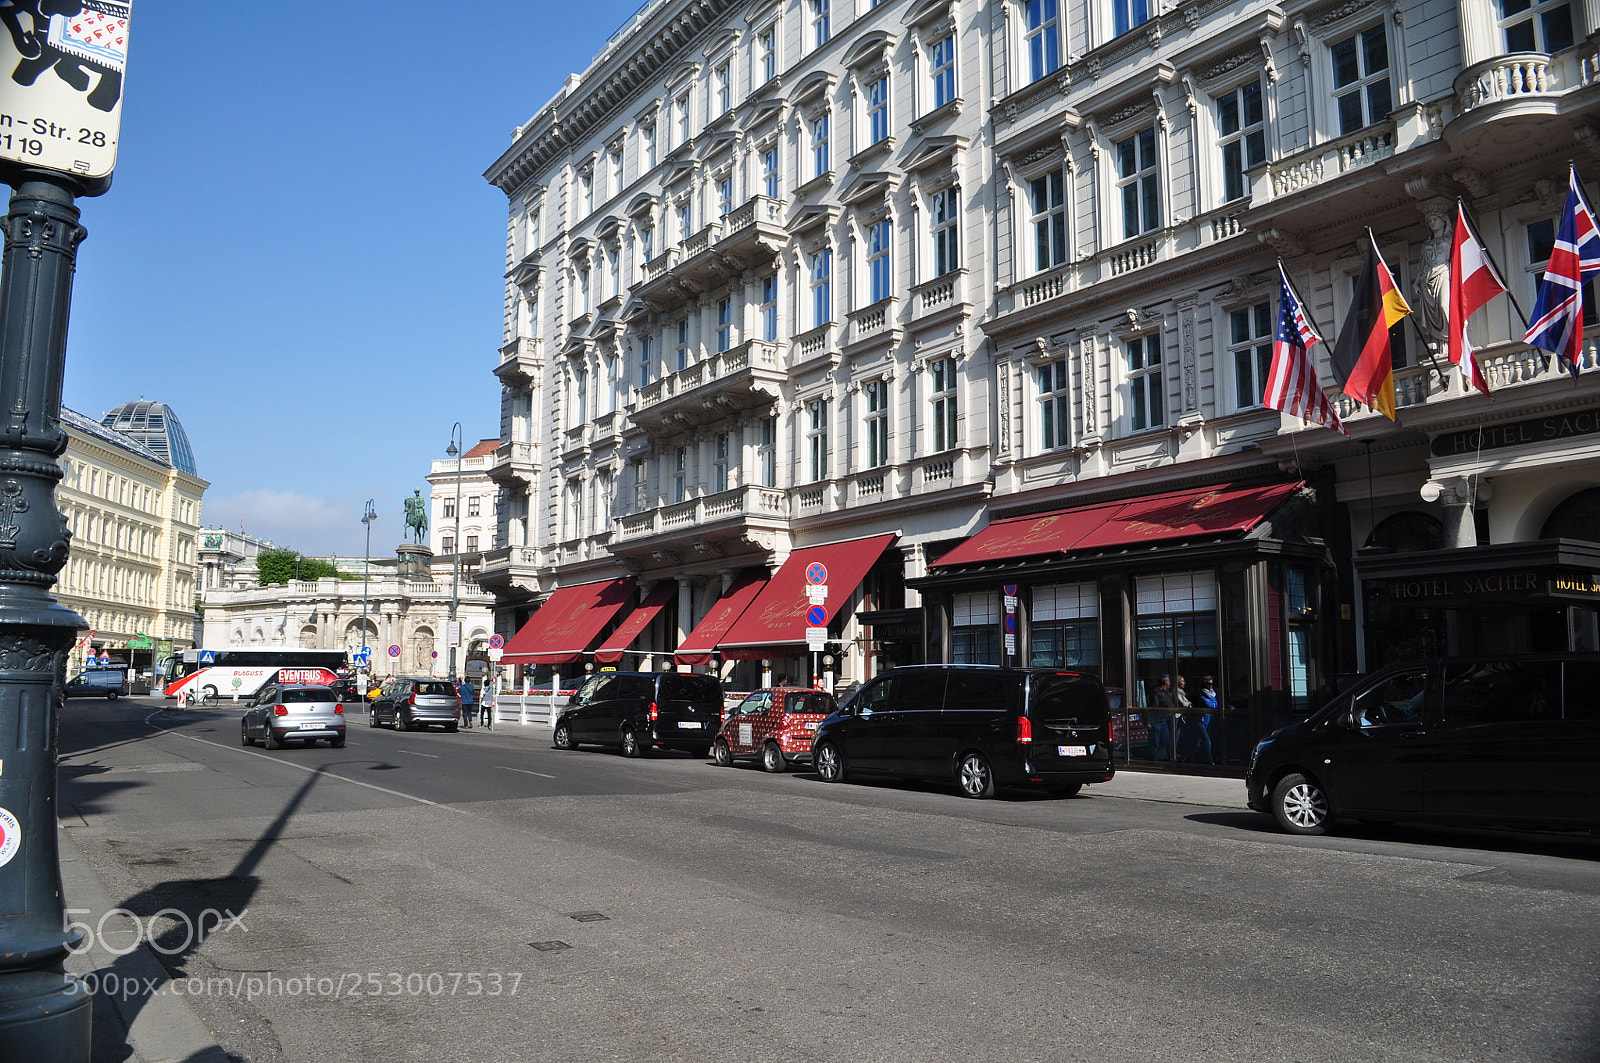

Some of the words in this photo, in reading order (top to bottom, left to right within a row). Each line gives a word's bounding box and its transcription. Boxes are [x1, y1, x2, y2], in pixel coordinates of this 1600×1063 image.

[77, 128, 106, 148] 28
[1453, 424, 1532, 452] HOTEL
[1395, 579, 1454, 598] HOTEL
[1463, 573, 1537, 593] SACHER
